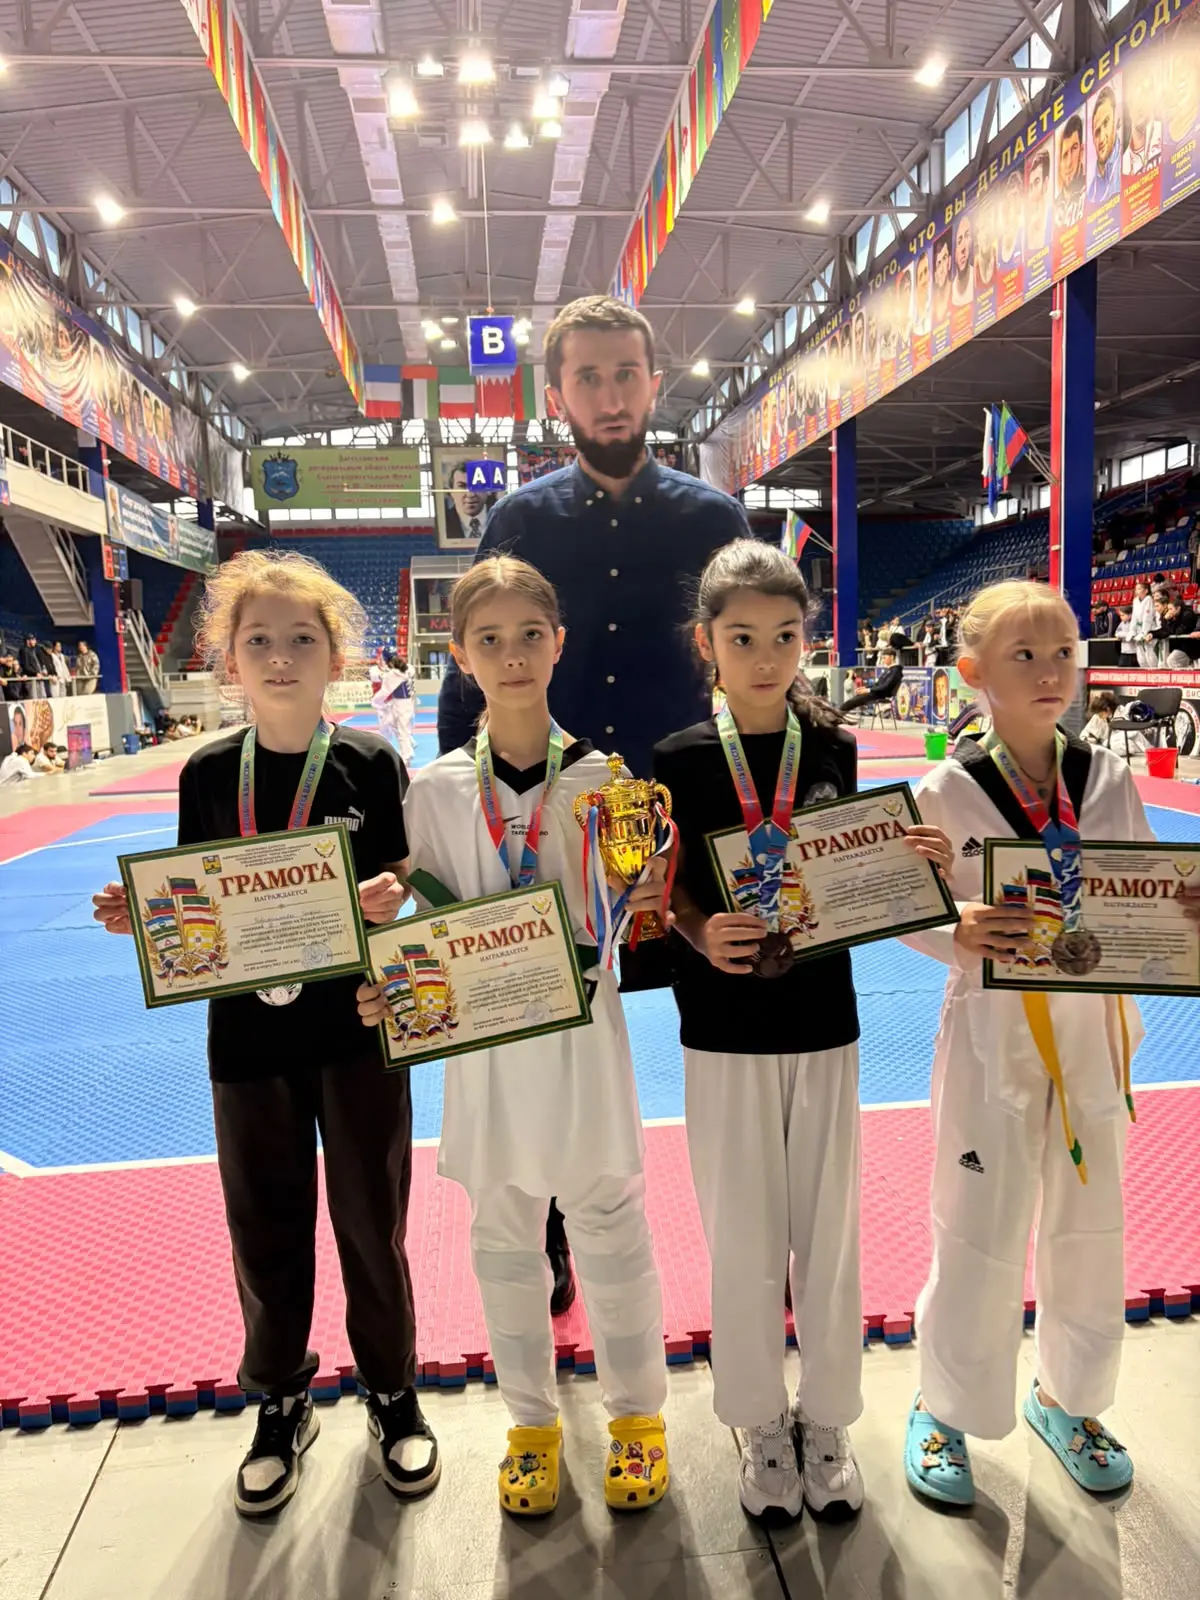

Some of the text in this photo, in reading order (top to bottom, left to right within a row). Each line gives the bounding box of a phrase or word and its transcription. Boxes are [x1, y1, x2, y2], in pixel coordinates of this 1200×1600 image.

[805, 308, 844, 354] ЗАВИСИТ
[849, 291, 862, 313] ОТ
[868, 259, 901, 294] ТОГО,
[909, 221, 936, 254] ЧТО
[945, 190, 966, 224] ВЫ
[976, 95, 1064, 198] ДЕЛАЕТЕ
[482, 326, 505, 355] B
[797, 820, 909, 862] ГРАМОТА
[833, 846, 885, 863] НАГРАЖДАЕТСЯ
[218, 861, 338, 898] ГРАМОТА
[254, 888, 308, 903] НАГРАЖДАЕТСЯ
[447, 918, 555, 960] ГРАМОТА
[479, 945, 529, 962] НАГРАЖДАЕТСЯ
